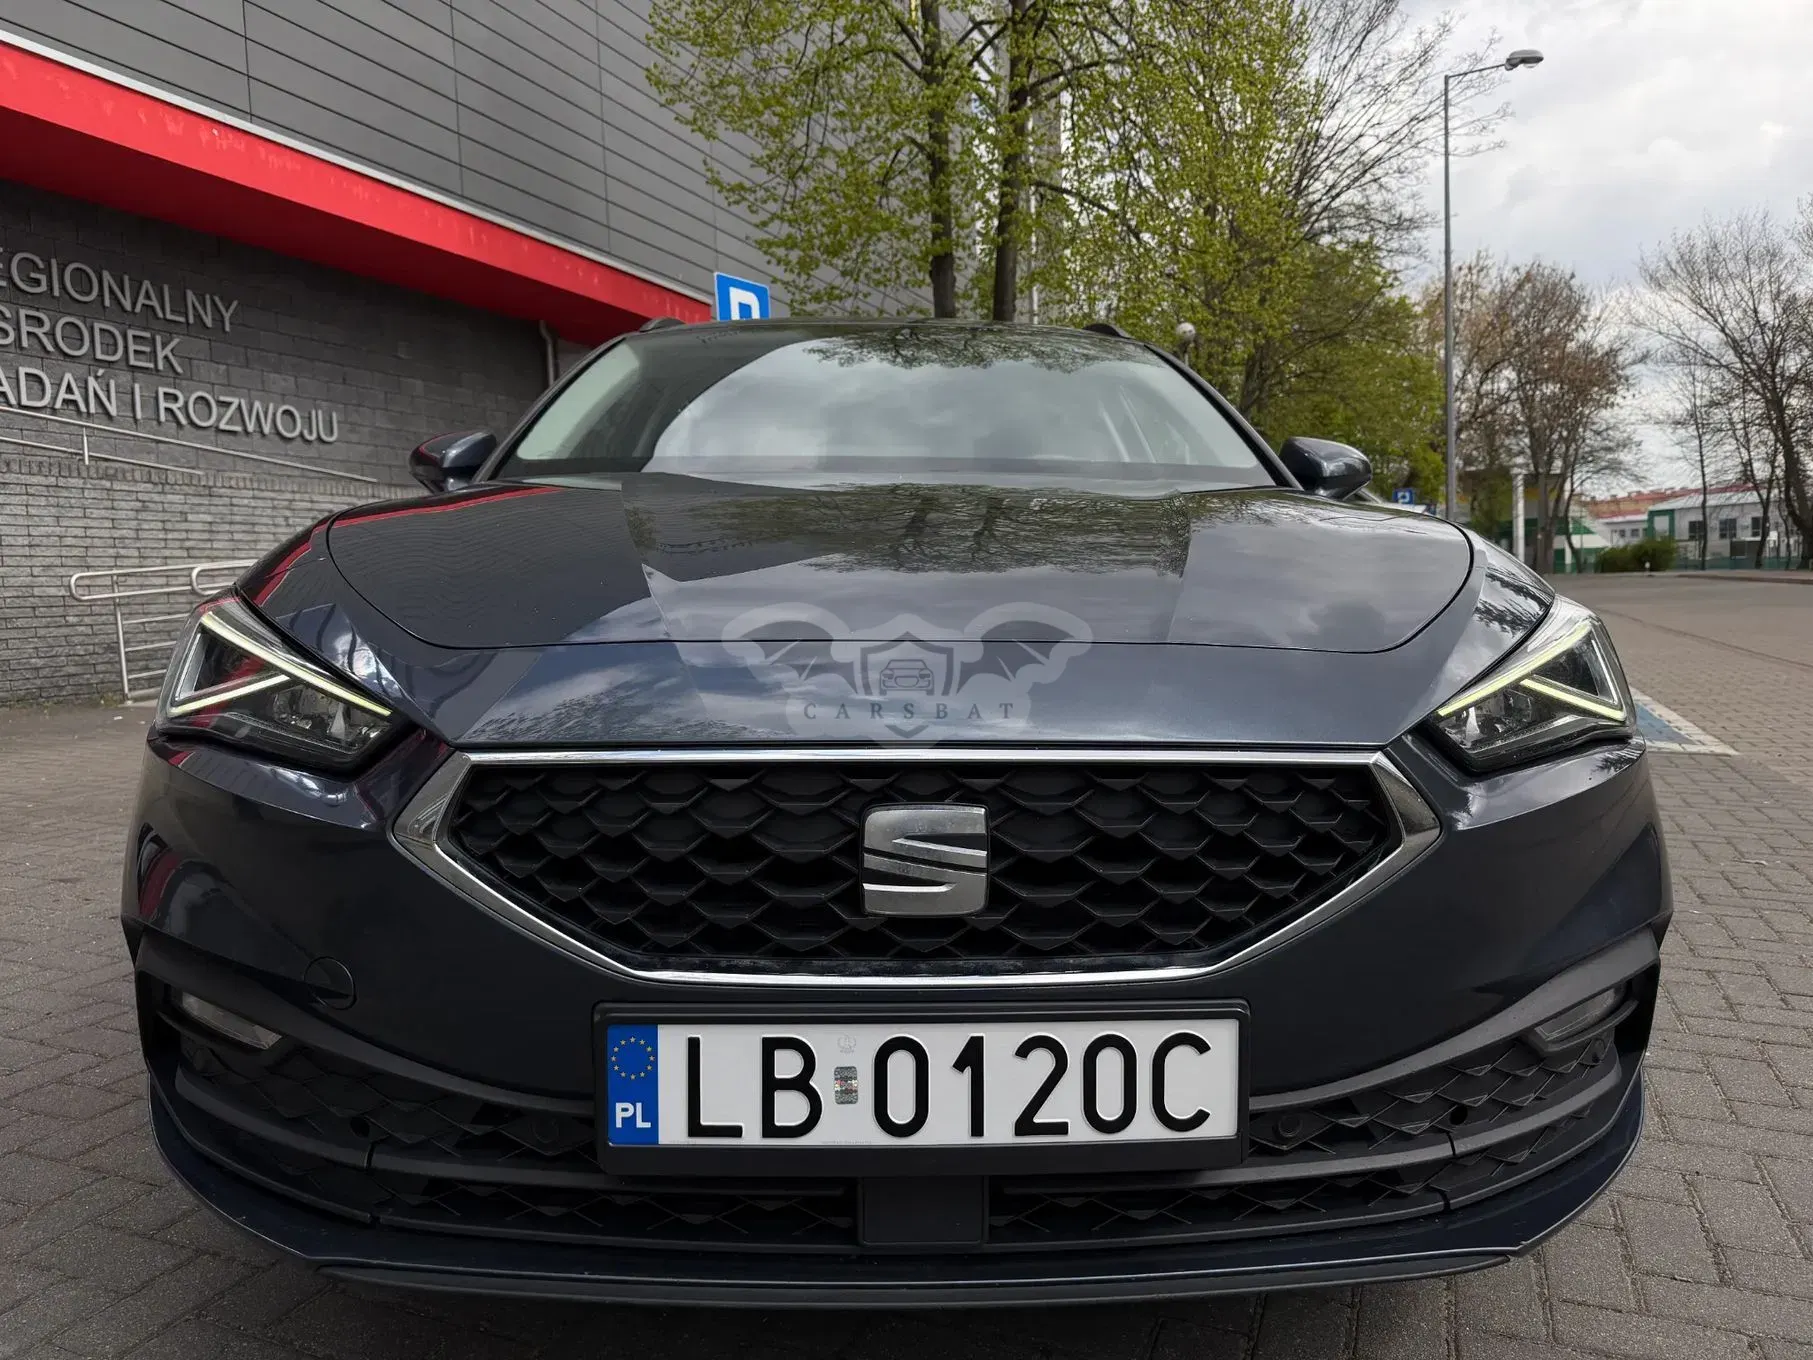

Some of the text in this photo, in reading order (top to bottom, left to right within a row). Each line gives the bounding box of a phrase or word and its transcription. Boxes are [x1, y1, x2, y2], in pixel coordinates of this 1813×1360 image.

[0, 247, 239, 333] GIONALNY
[133, 383, 142, 420] I
[157, 386, 339, 443] ROZWOJU
[615, 1102, 652, 1128] PL
[686, 1032, 1212, 1138] LB 0120C
